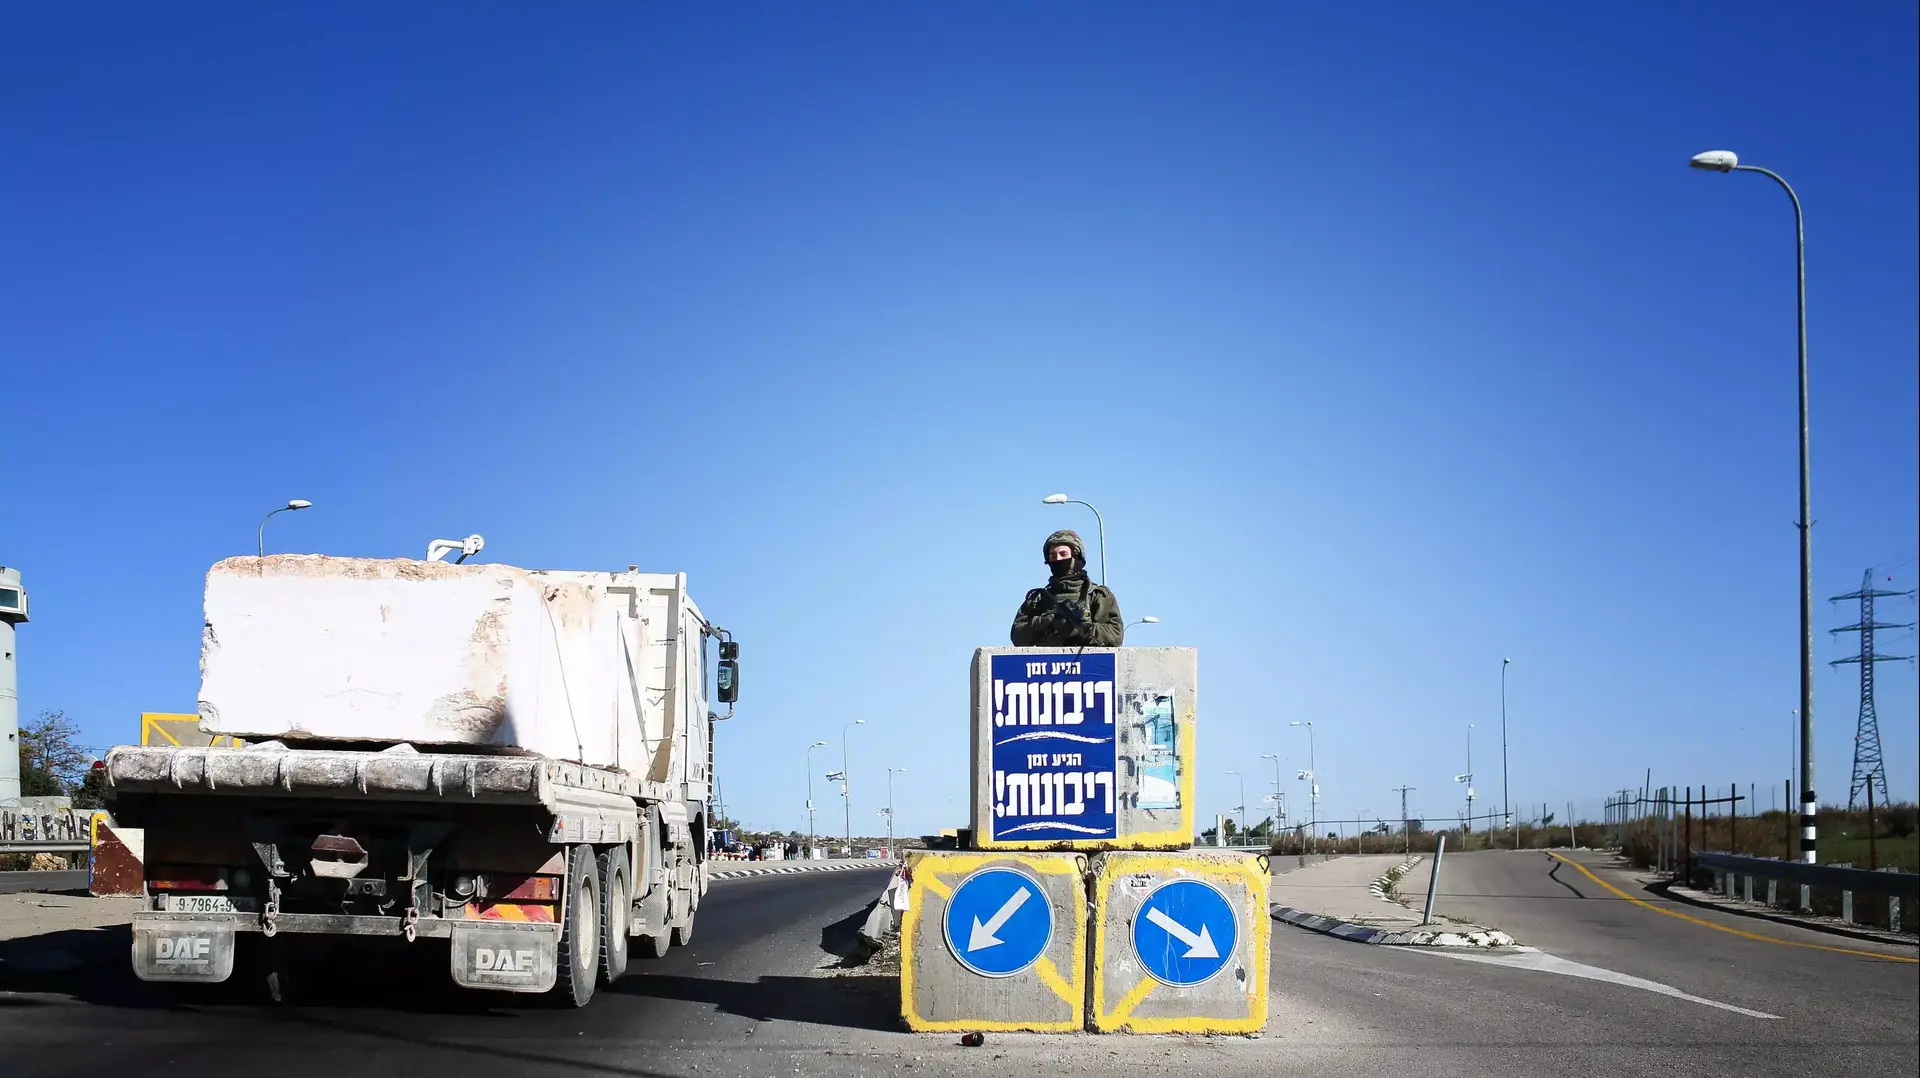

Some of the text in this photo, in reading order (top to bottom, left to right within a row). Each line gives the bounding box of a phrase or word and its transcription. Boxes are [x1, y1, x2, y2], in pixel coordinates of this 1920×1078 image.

[1026, 661, 1081, 679] הגיע זמן
[994, 679, 1113, 728] ריבונות!
[1027, 753, 1082, 770] הגיע זמן
[995, 770, 1114, 818] ריבונות!
[156, 938, 210, 959] DAF
[476, 948, 534, 970] DAF
